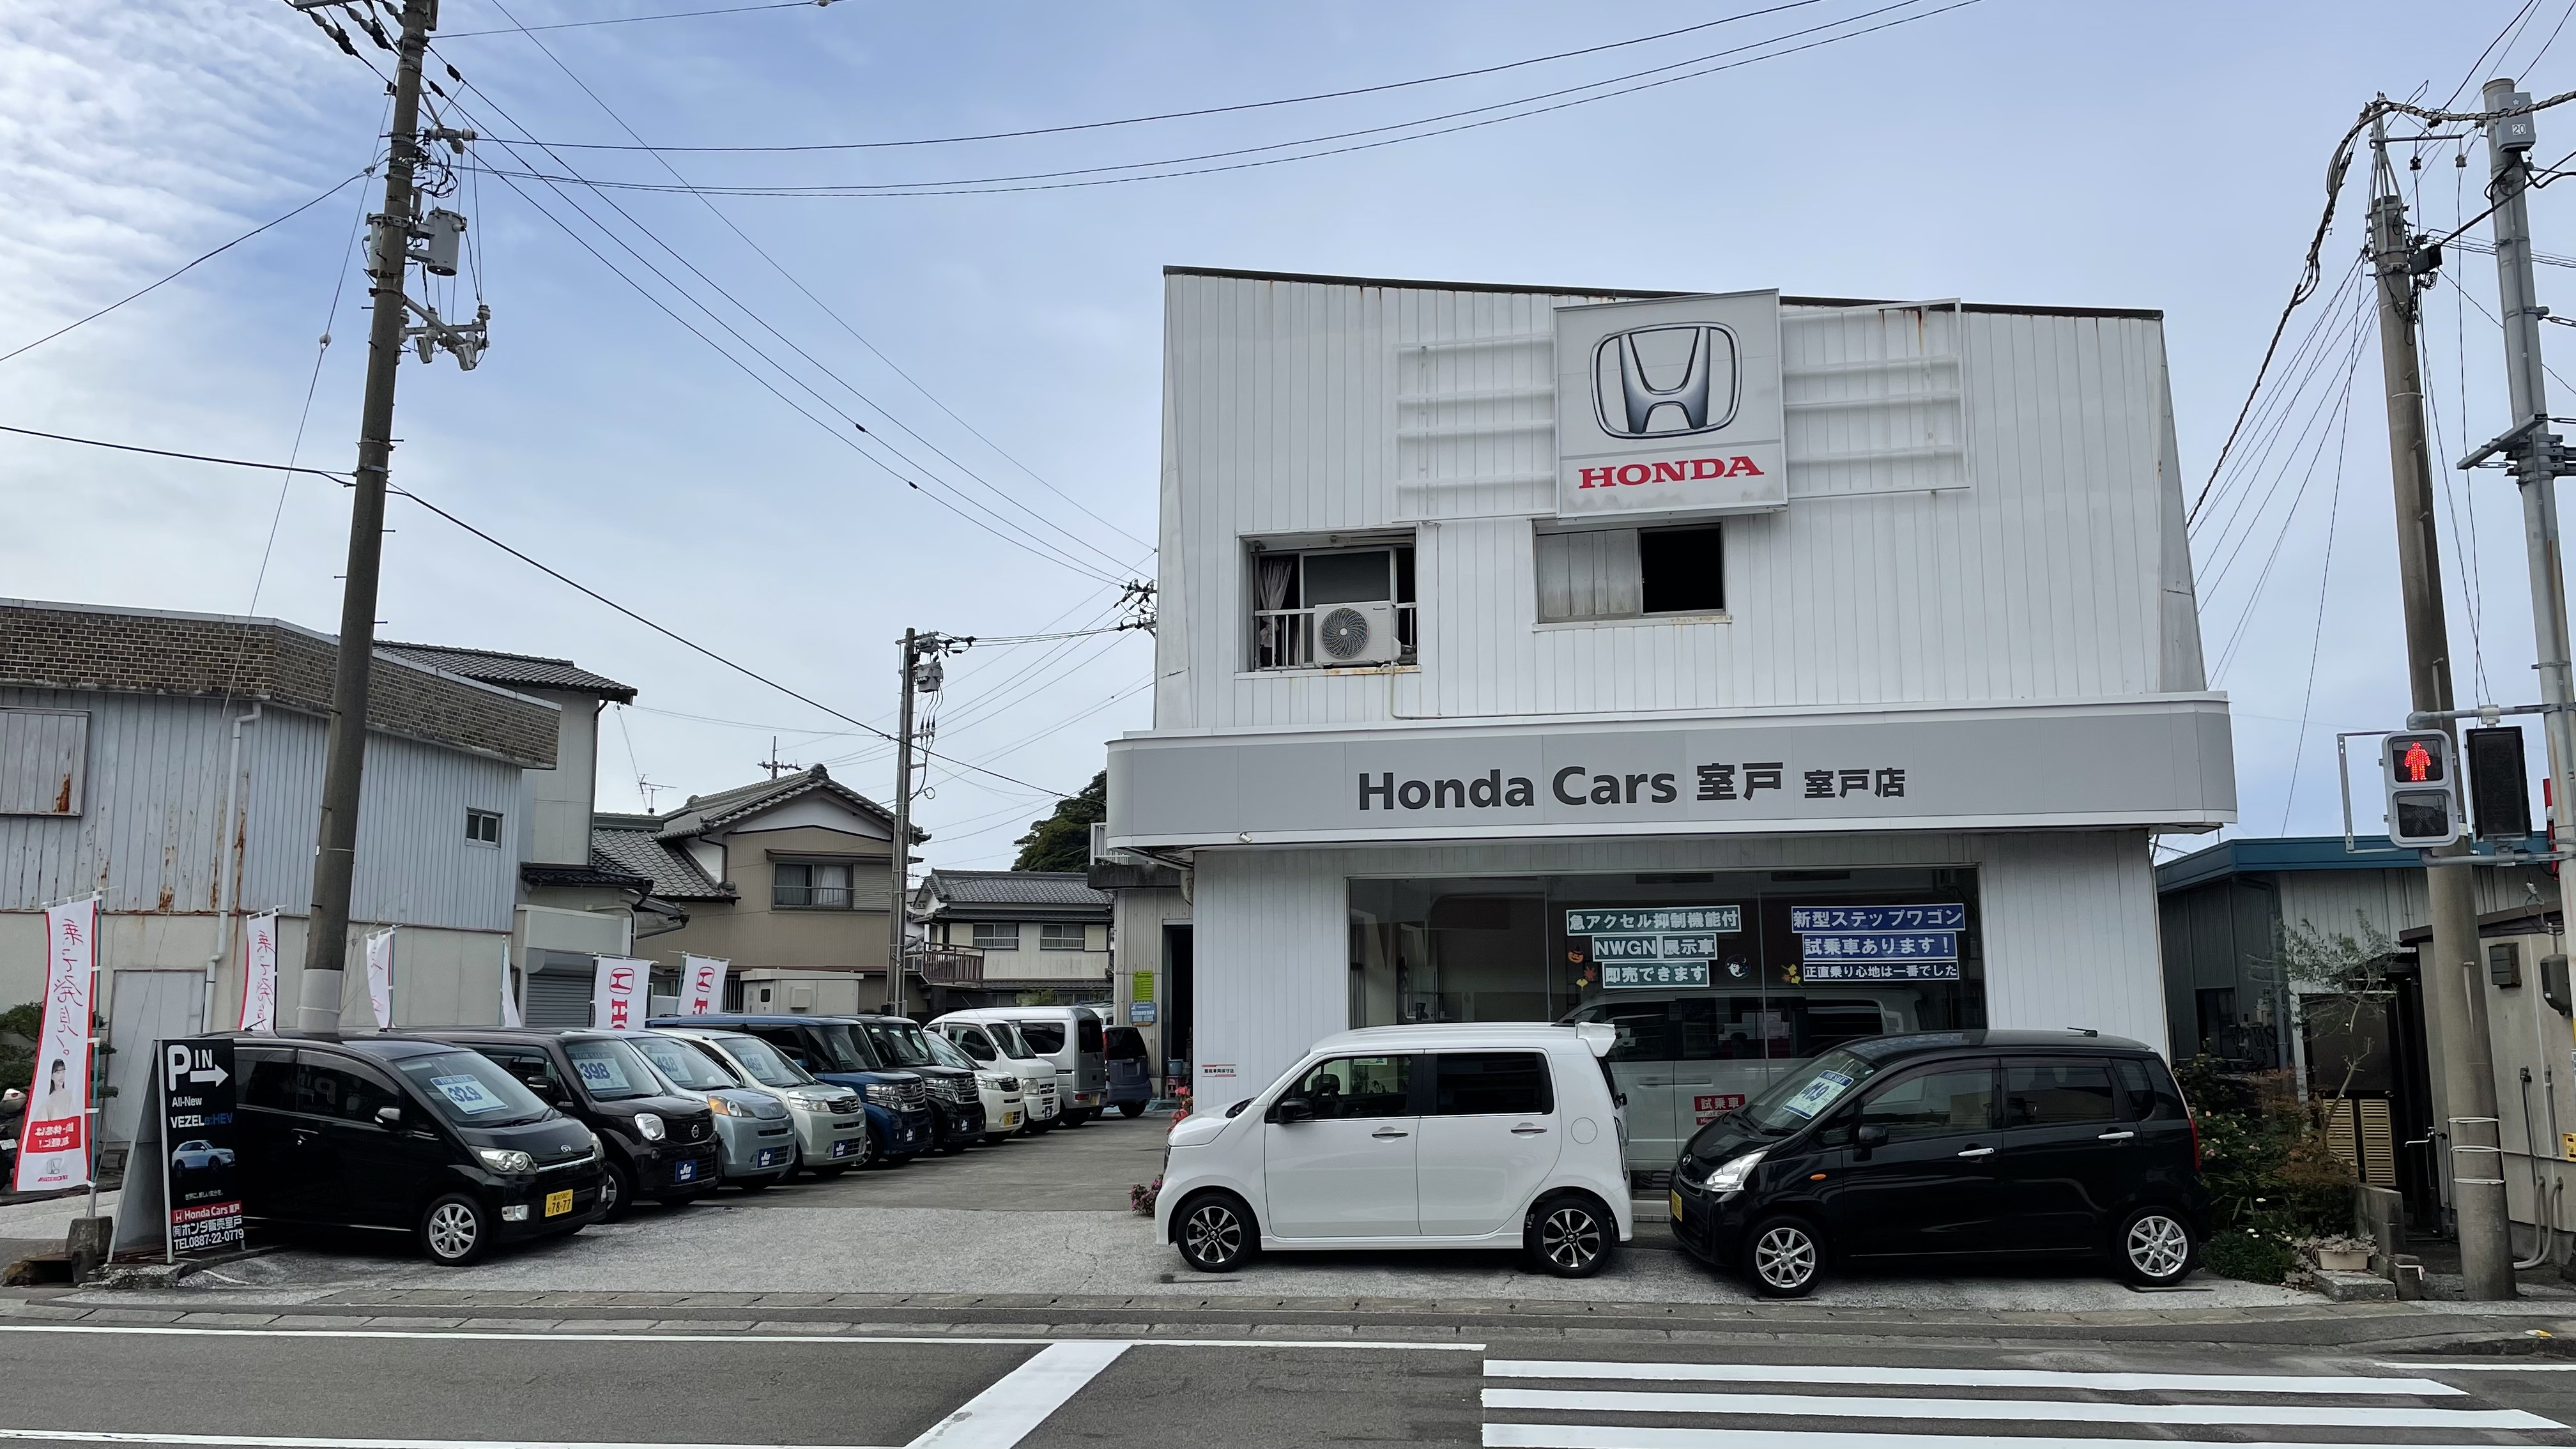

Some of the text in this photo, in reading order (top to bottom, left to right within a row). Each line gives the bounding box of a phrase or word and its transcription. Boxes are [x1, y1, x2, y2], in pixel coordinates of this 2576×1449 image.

[2513, 125, 2525, 134] 20
[1578, 456, 1765, 489] HONDA
[1360, 762, 1905, 810] Honda Cars 室戸 室戸店
[1569, 910, 1738, 931] 急アクセル抑制機能付
[1793, 909, 1962, 928] 新型ステップワゴン
[1595, 939, 1715, 956] NWGN 展示車
[1605, 965, 1706, 983] 即売できます
[1805, 965, 1958, 978] 正直乗り心地は一番でした
[167, 1045, 213, 1091] P IN
[1701, 1096, 1740, 1110] 試乗車
[170, 1114, 204, 1128] VEZEL
[185, 1208, 210, 1220] Honda
[211, 1206, 229, 1216] Cars
